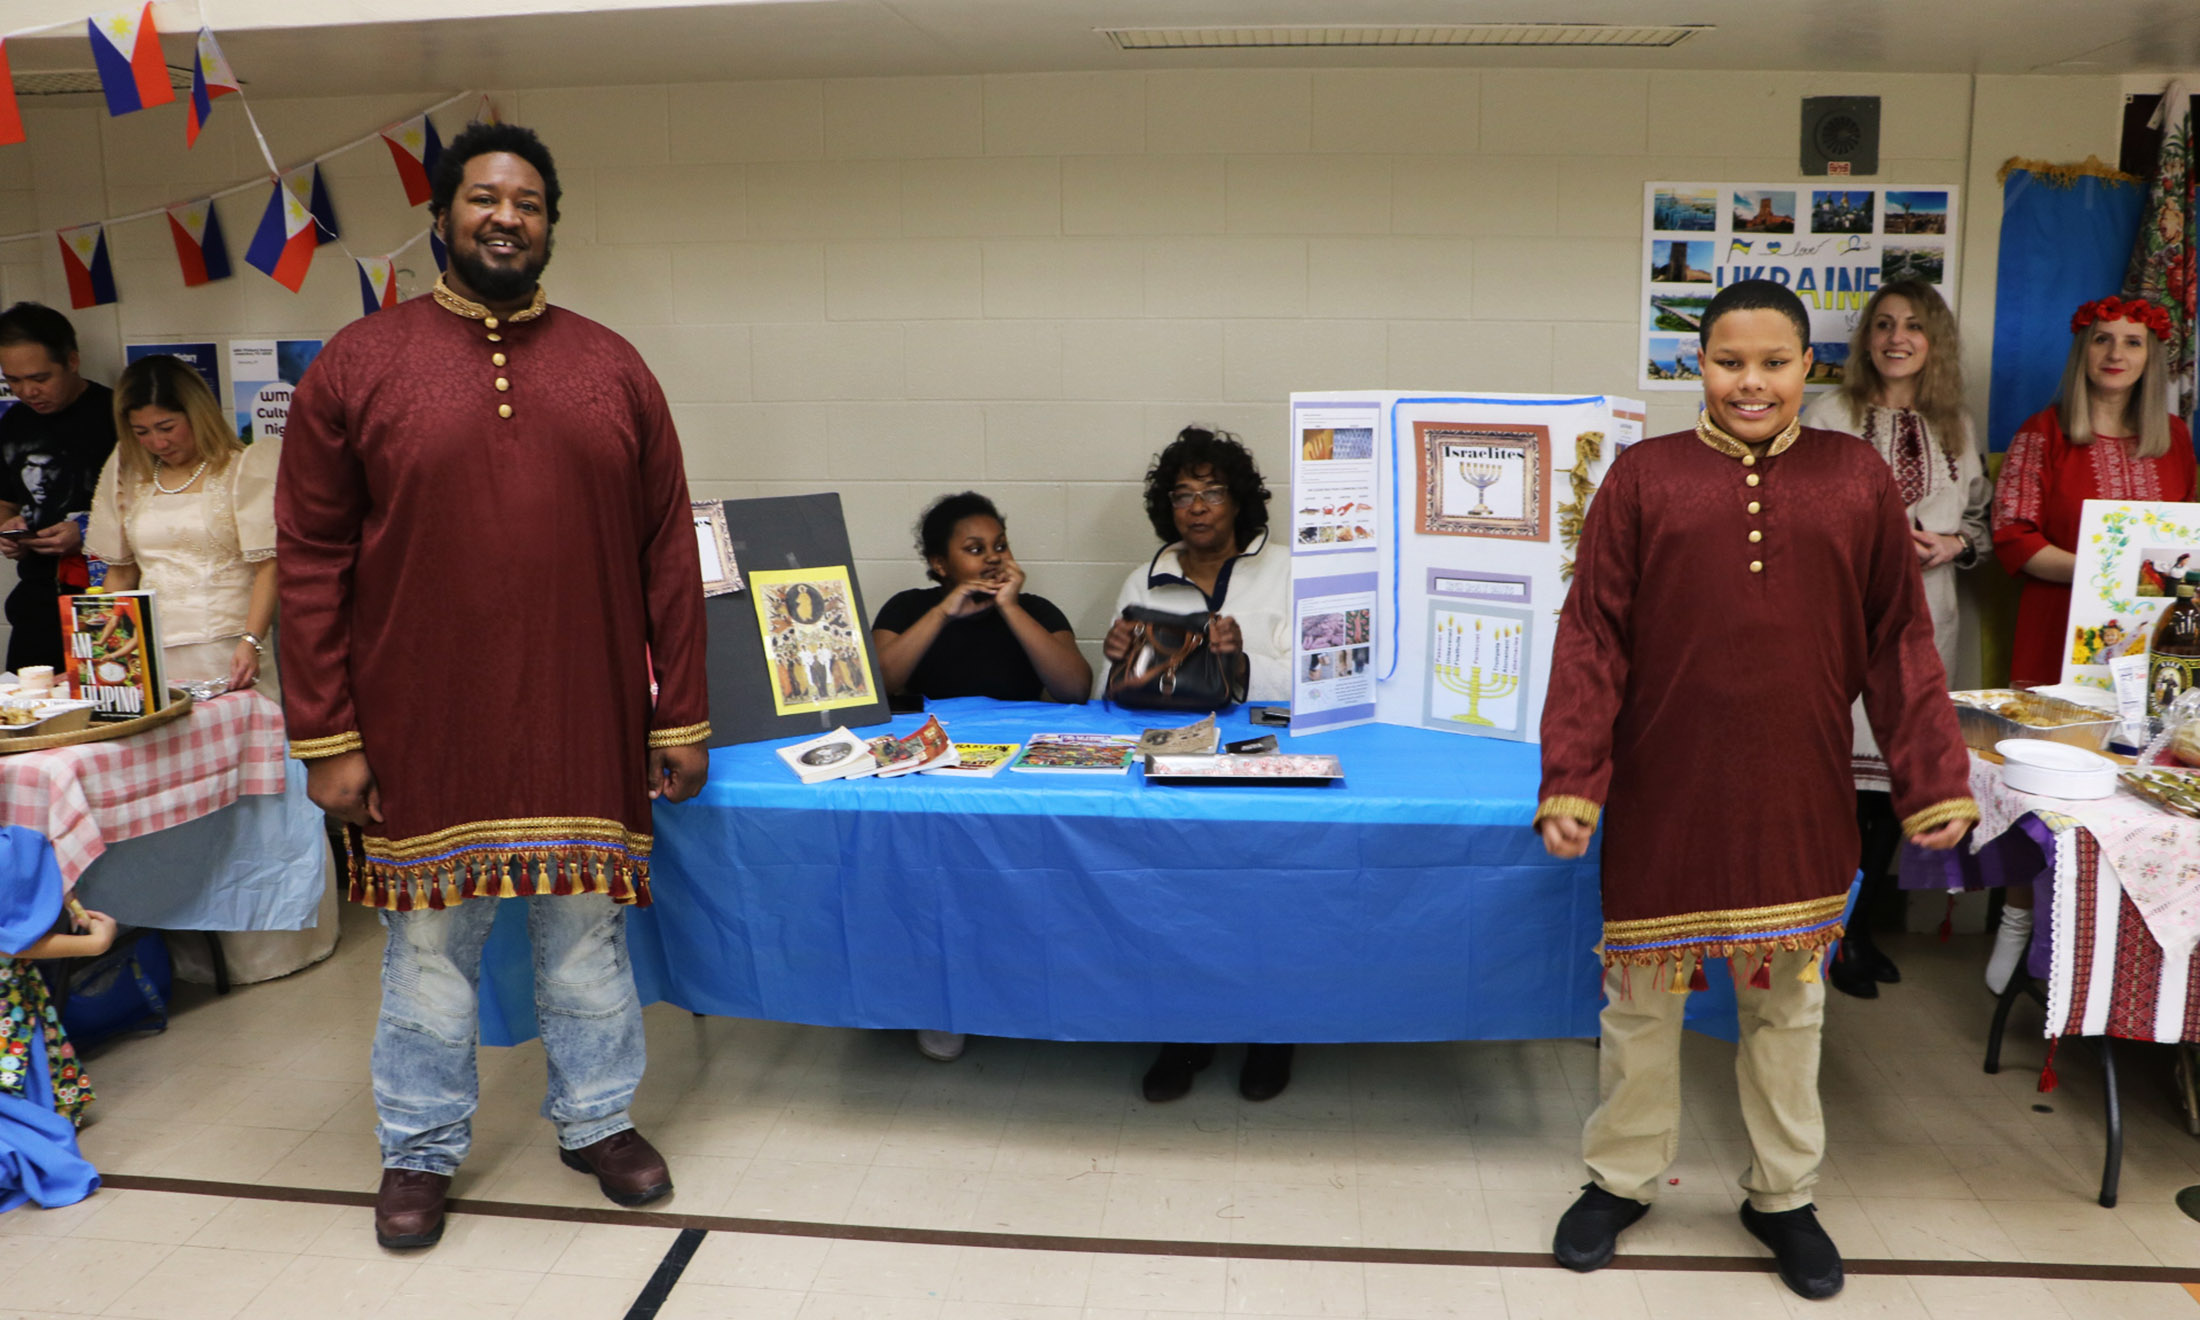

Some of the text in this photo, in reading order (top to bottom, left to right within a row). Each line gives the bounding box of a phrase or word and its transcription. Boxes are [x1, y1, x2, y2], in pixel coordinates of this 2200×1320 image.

[260, 391, 295, 402] wm
[1444, 446, 1525, 459] Israelites
[71, 632, 93, 659] AM
[86, 659, 97, 685] A
[81, 684, 141, 713] FILIPINO
